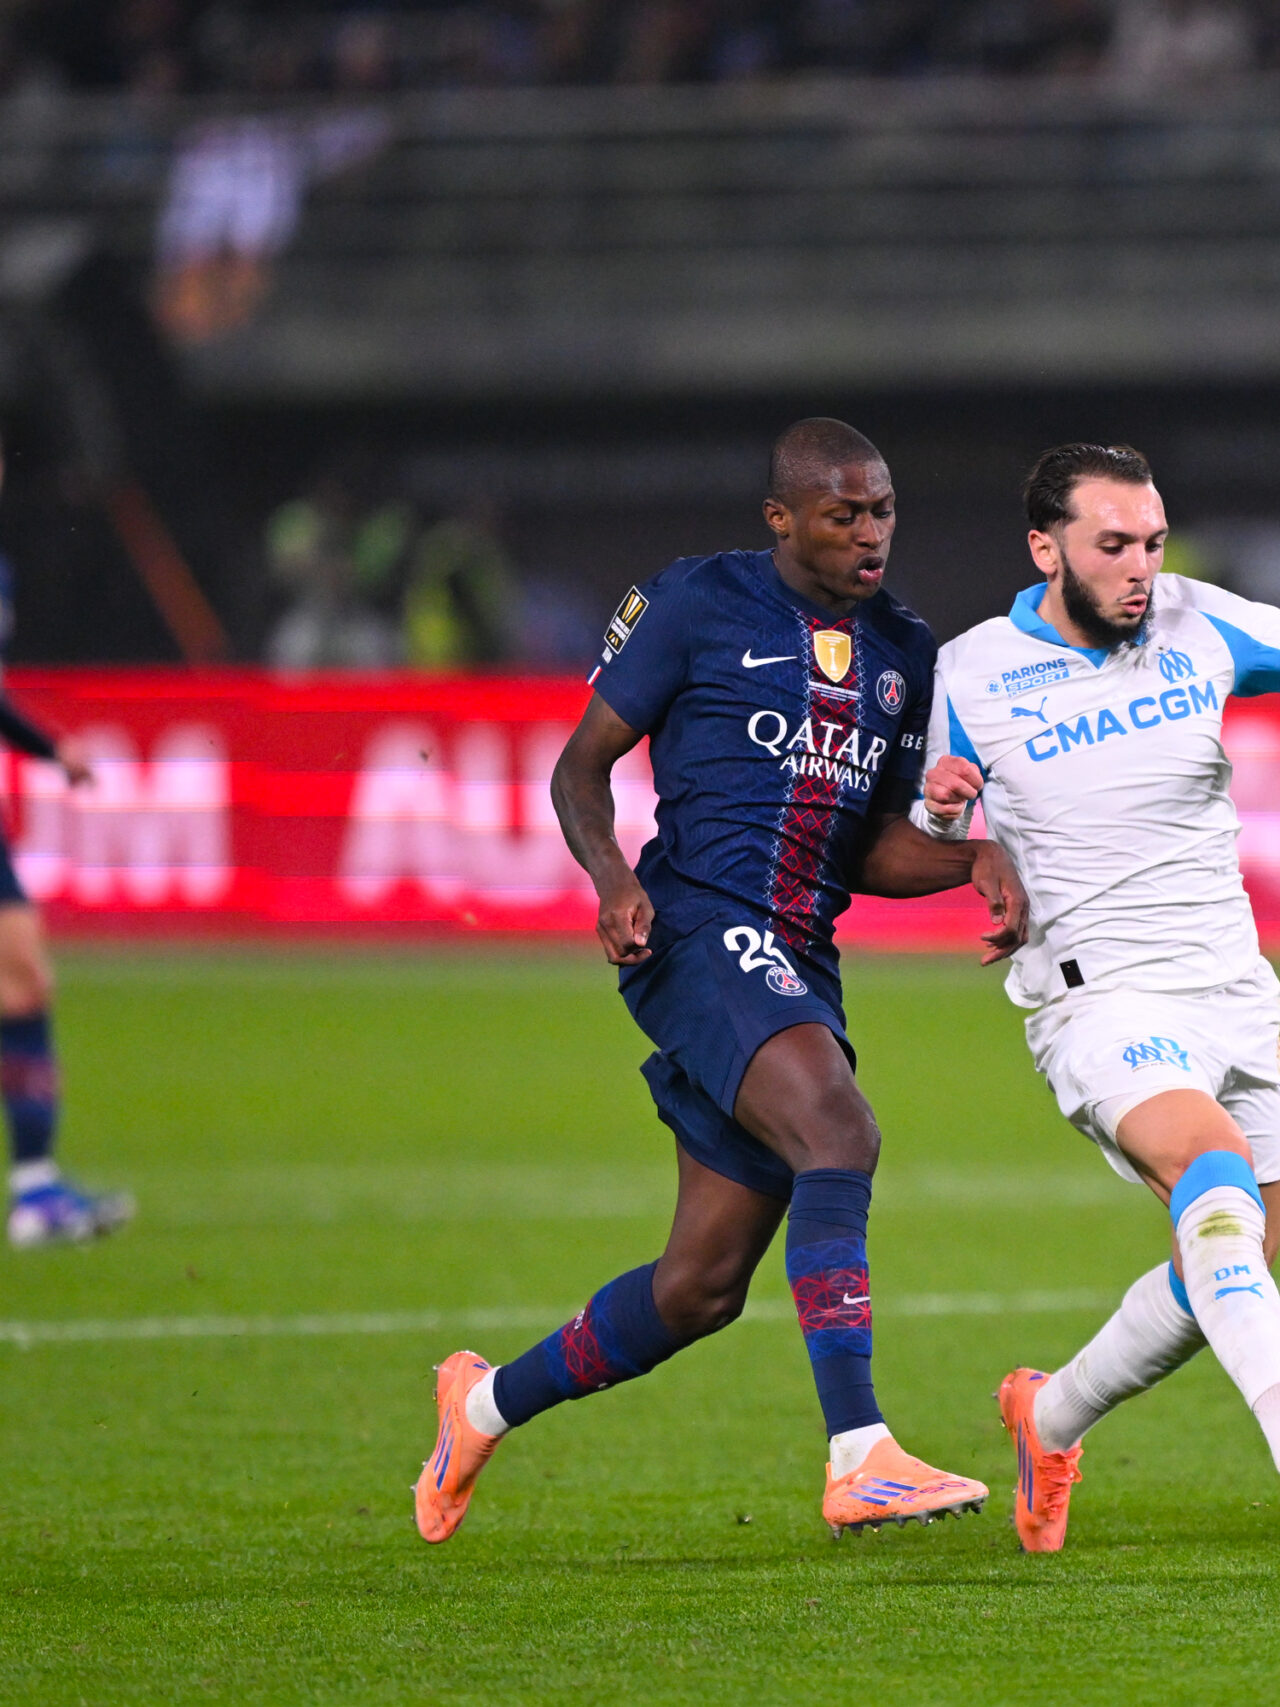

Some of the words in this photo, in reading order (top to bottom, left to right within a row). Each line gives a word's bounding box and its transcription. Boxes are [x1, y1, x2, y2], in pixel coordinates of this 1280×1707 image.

[1001, 658, 1067, 684] PARIONS
[1006, 668, 1070, 692] SPORT
[747, 710, 887, 772] QATAR
[1025, 708, 1128, 762] CMA
[1128, 680, 1218, 731] CGM
[779, 752, 873, 792] AIRWAYS
